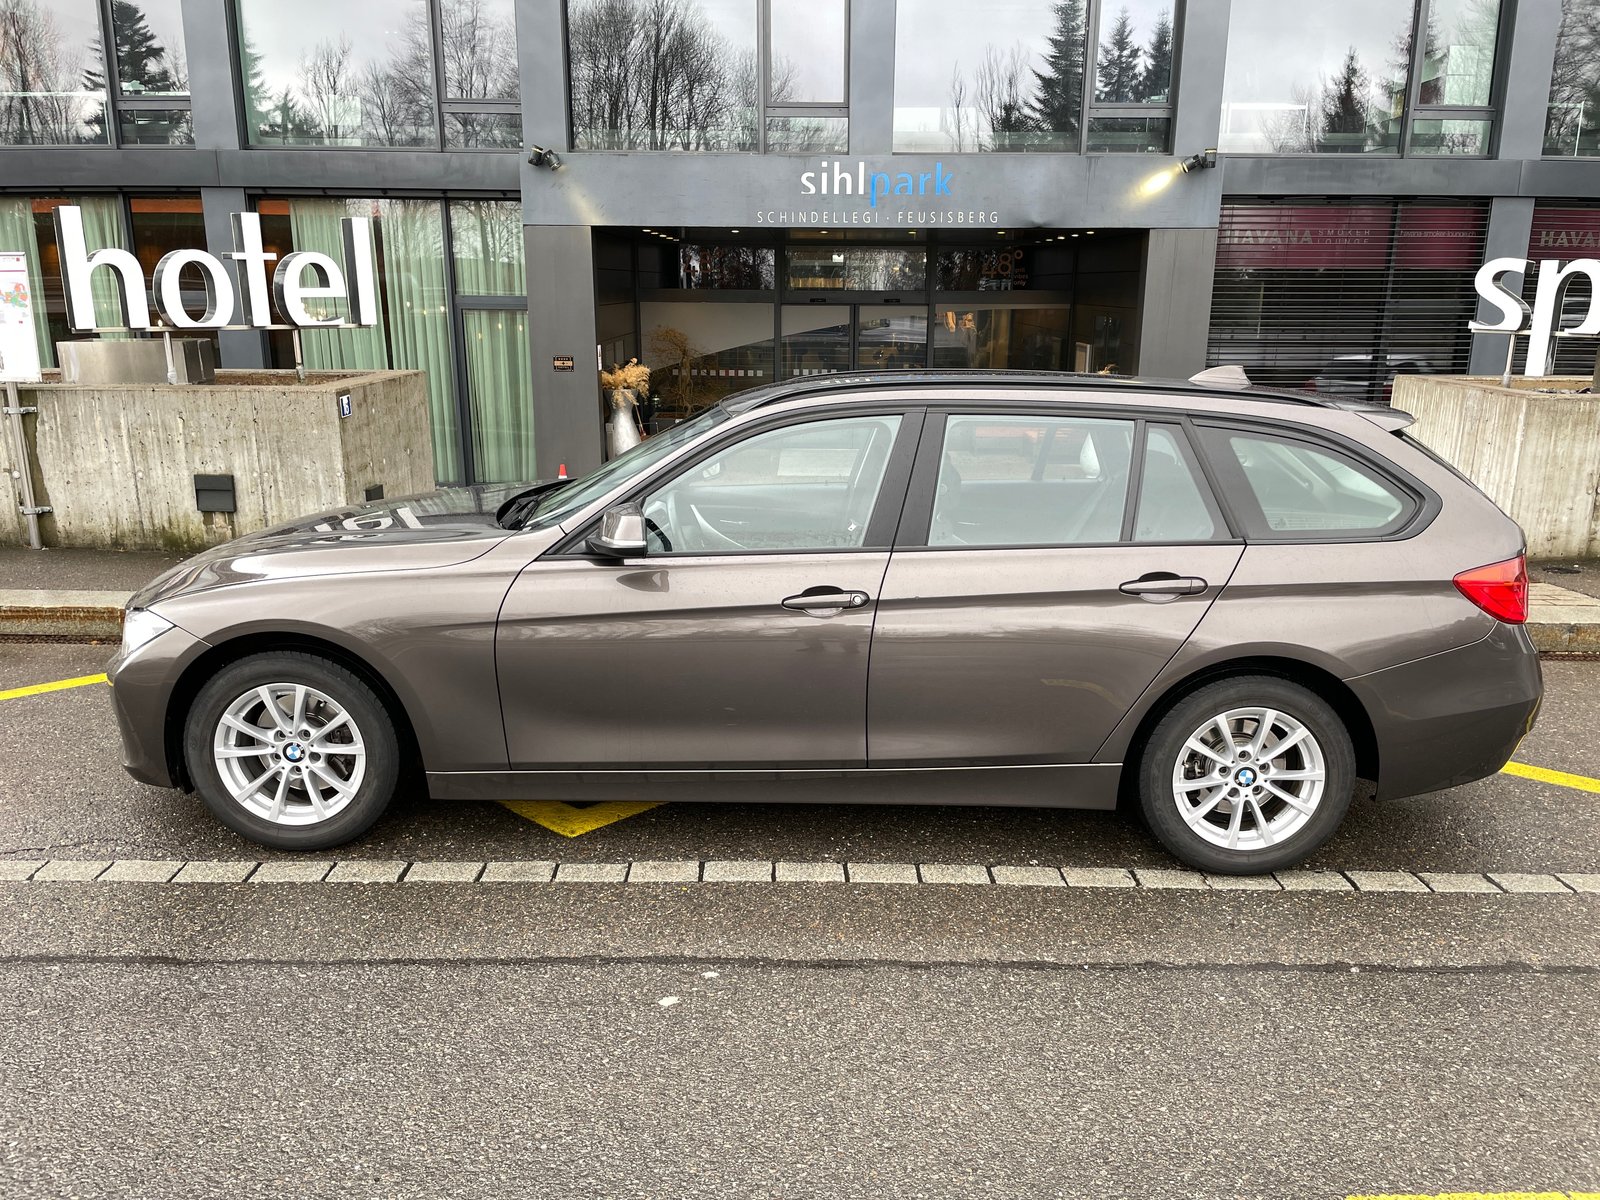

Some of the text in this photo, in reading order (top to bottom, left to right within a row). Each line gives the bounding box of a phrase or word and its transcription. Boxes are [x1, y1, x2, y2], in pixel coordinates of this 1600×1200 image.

[800, 160, 953, 209] sihlpark
[756, 210, 999, 224] SCHINDELLEGI FEUSISBERG
[1539, 230, 1600, 248] HAVA
[53, 205, 378, 330] hotel
